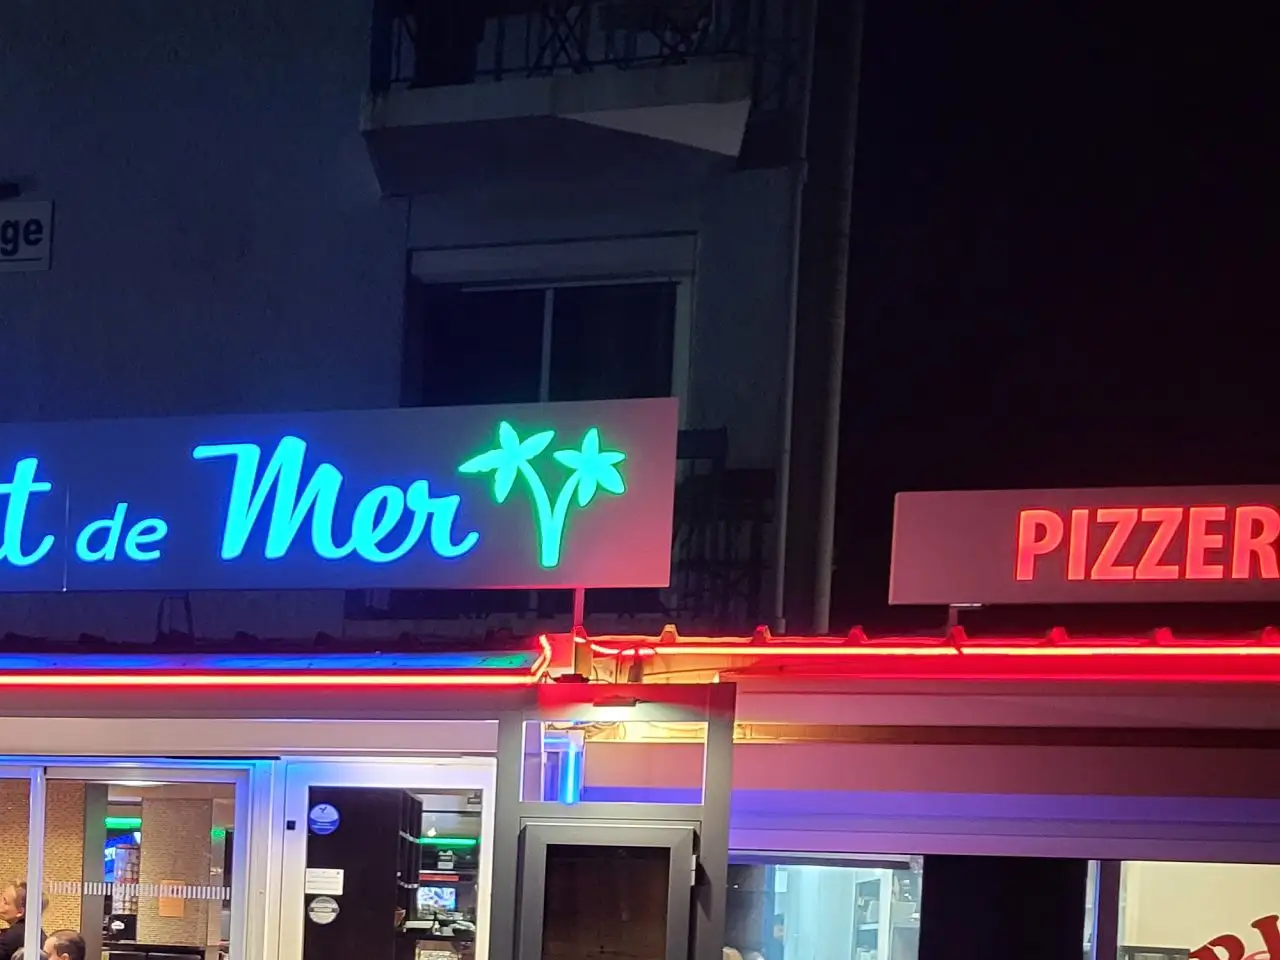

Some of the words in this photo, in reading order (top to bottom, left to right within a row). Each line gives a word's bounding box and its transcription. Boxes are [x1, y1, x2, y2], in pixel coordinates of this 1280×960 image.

[75, 501, 168, 562] de
[192, 435, 480, 563] Mer
[1016, 505, 1280, 581] PIZZER
